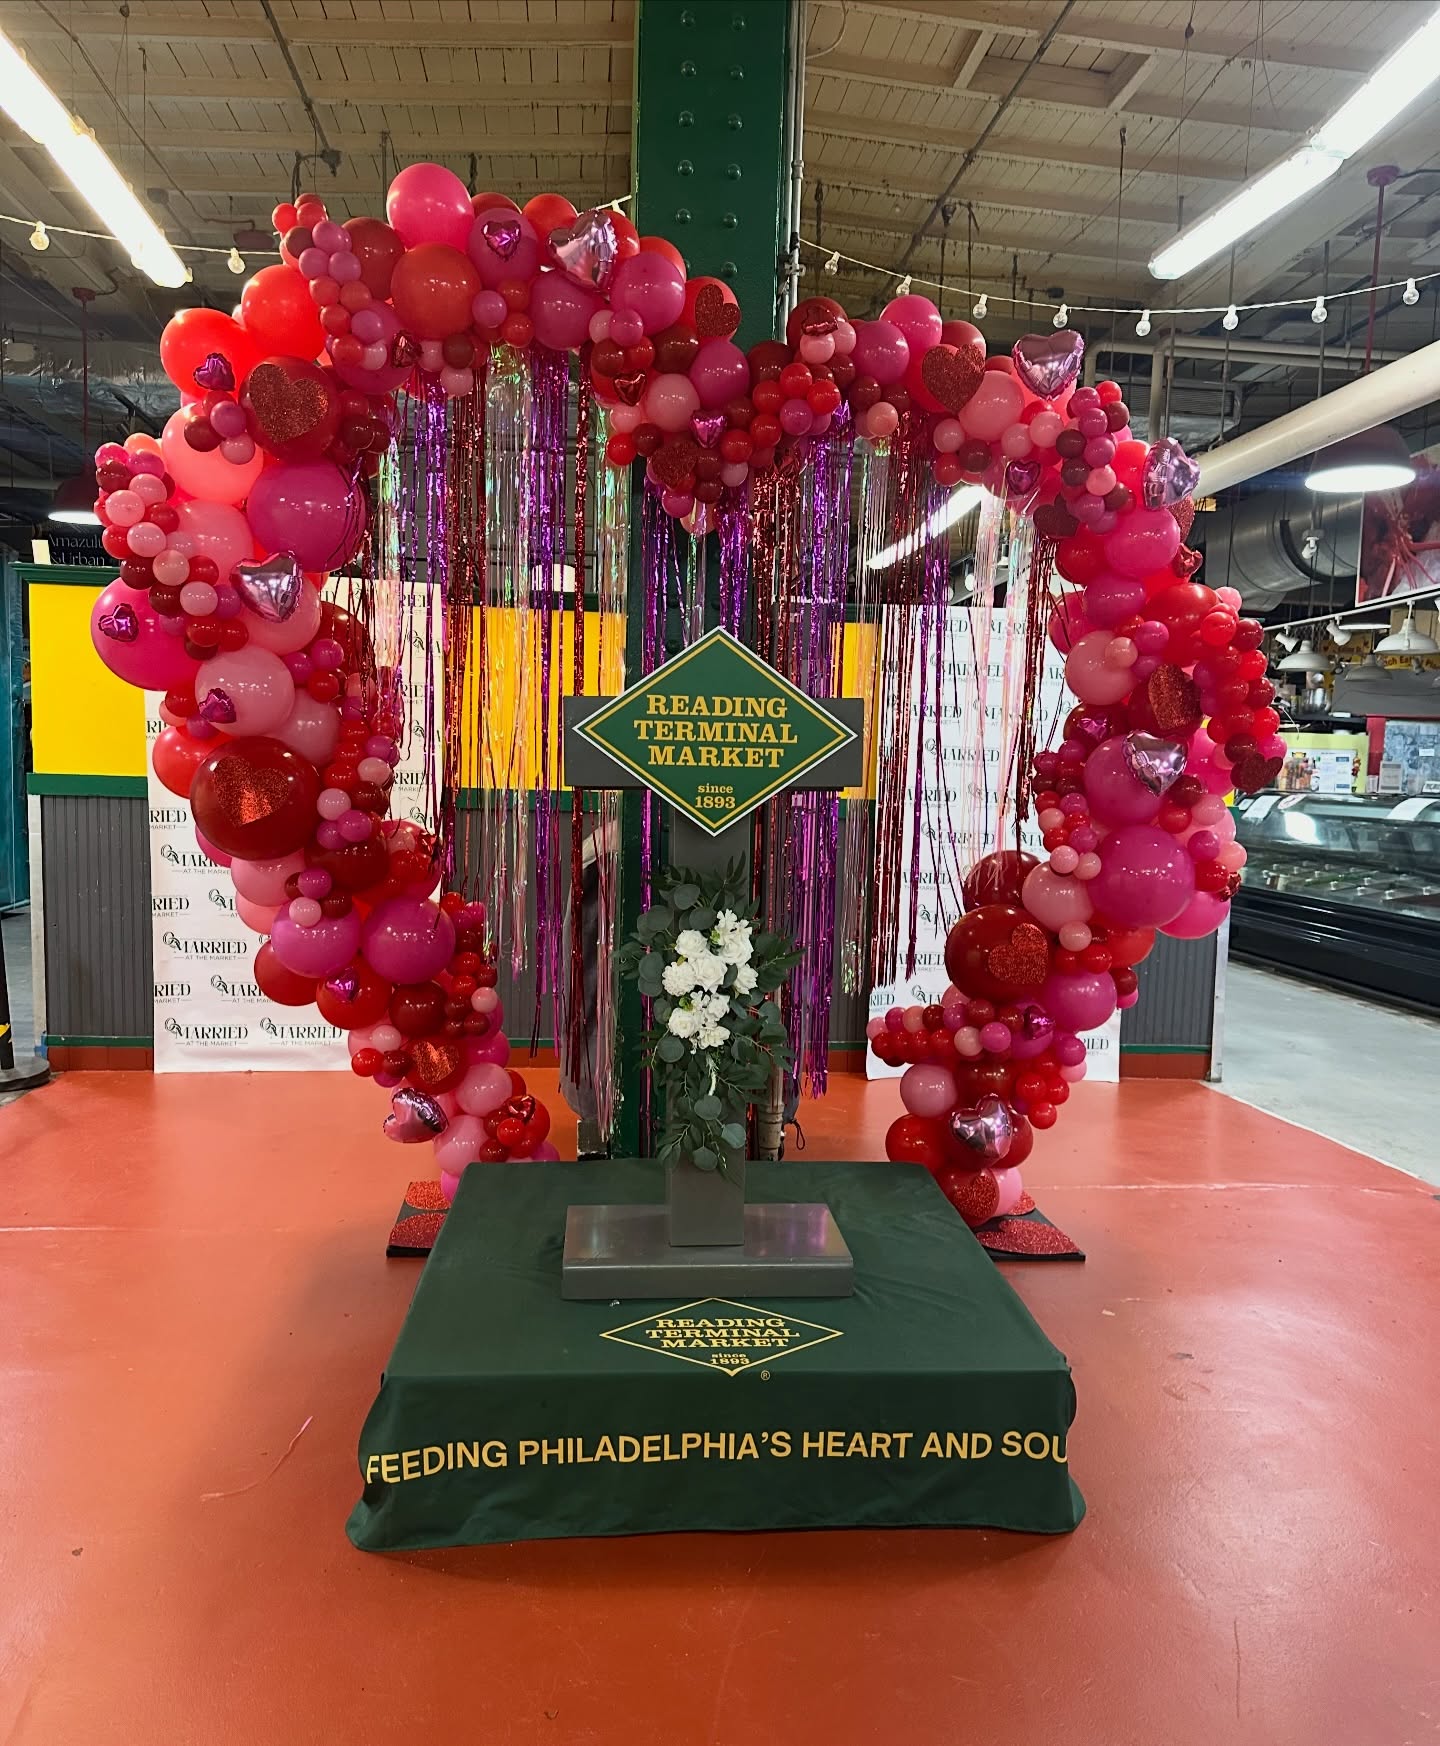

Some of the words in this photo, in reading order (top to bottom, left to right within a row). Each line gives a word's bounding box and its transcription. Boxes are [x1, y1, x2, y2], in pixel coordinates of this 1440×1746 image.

[646, 694, 788, 719] READING
[633, 720, 798, 744] TERMINAL
[648, 745, 784, 768] MARKET
[697, 783, 734, 794] since
[695, 796, 736, 809] 1893
[173, 941, 248, 954] MARRIED
[174, 1026, 248, 1039] MARRIED
[656, 1318, 786, 1328] READING
[645, 1328, 800, 1339] TERMINAL
[660, 1338, 789, 1348] MARKET
[366, 1440, 508, 1484] FEEDING
[519, 1431, 791, 1465] PHILADELPHIA’S
[803, 1431, 913, 1458] HEART
[920, 1432, 992, 1459] AND
